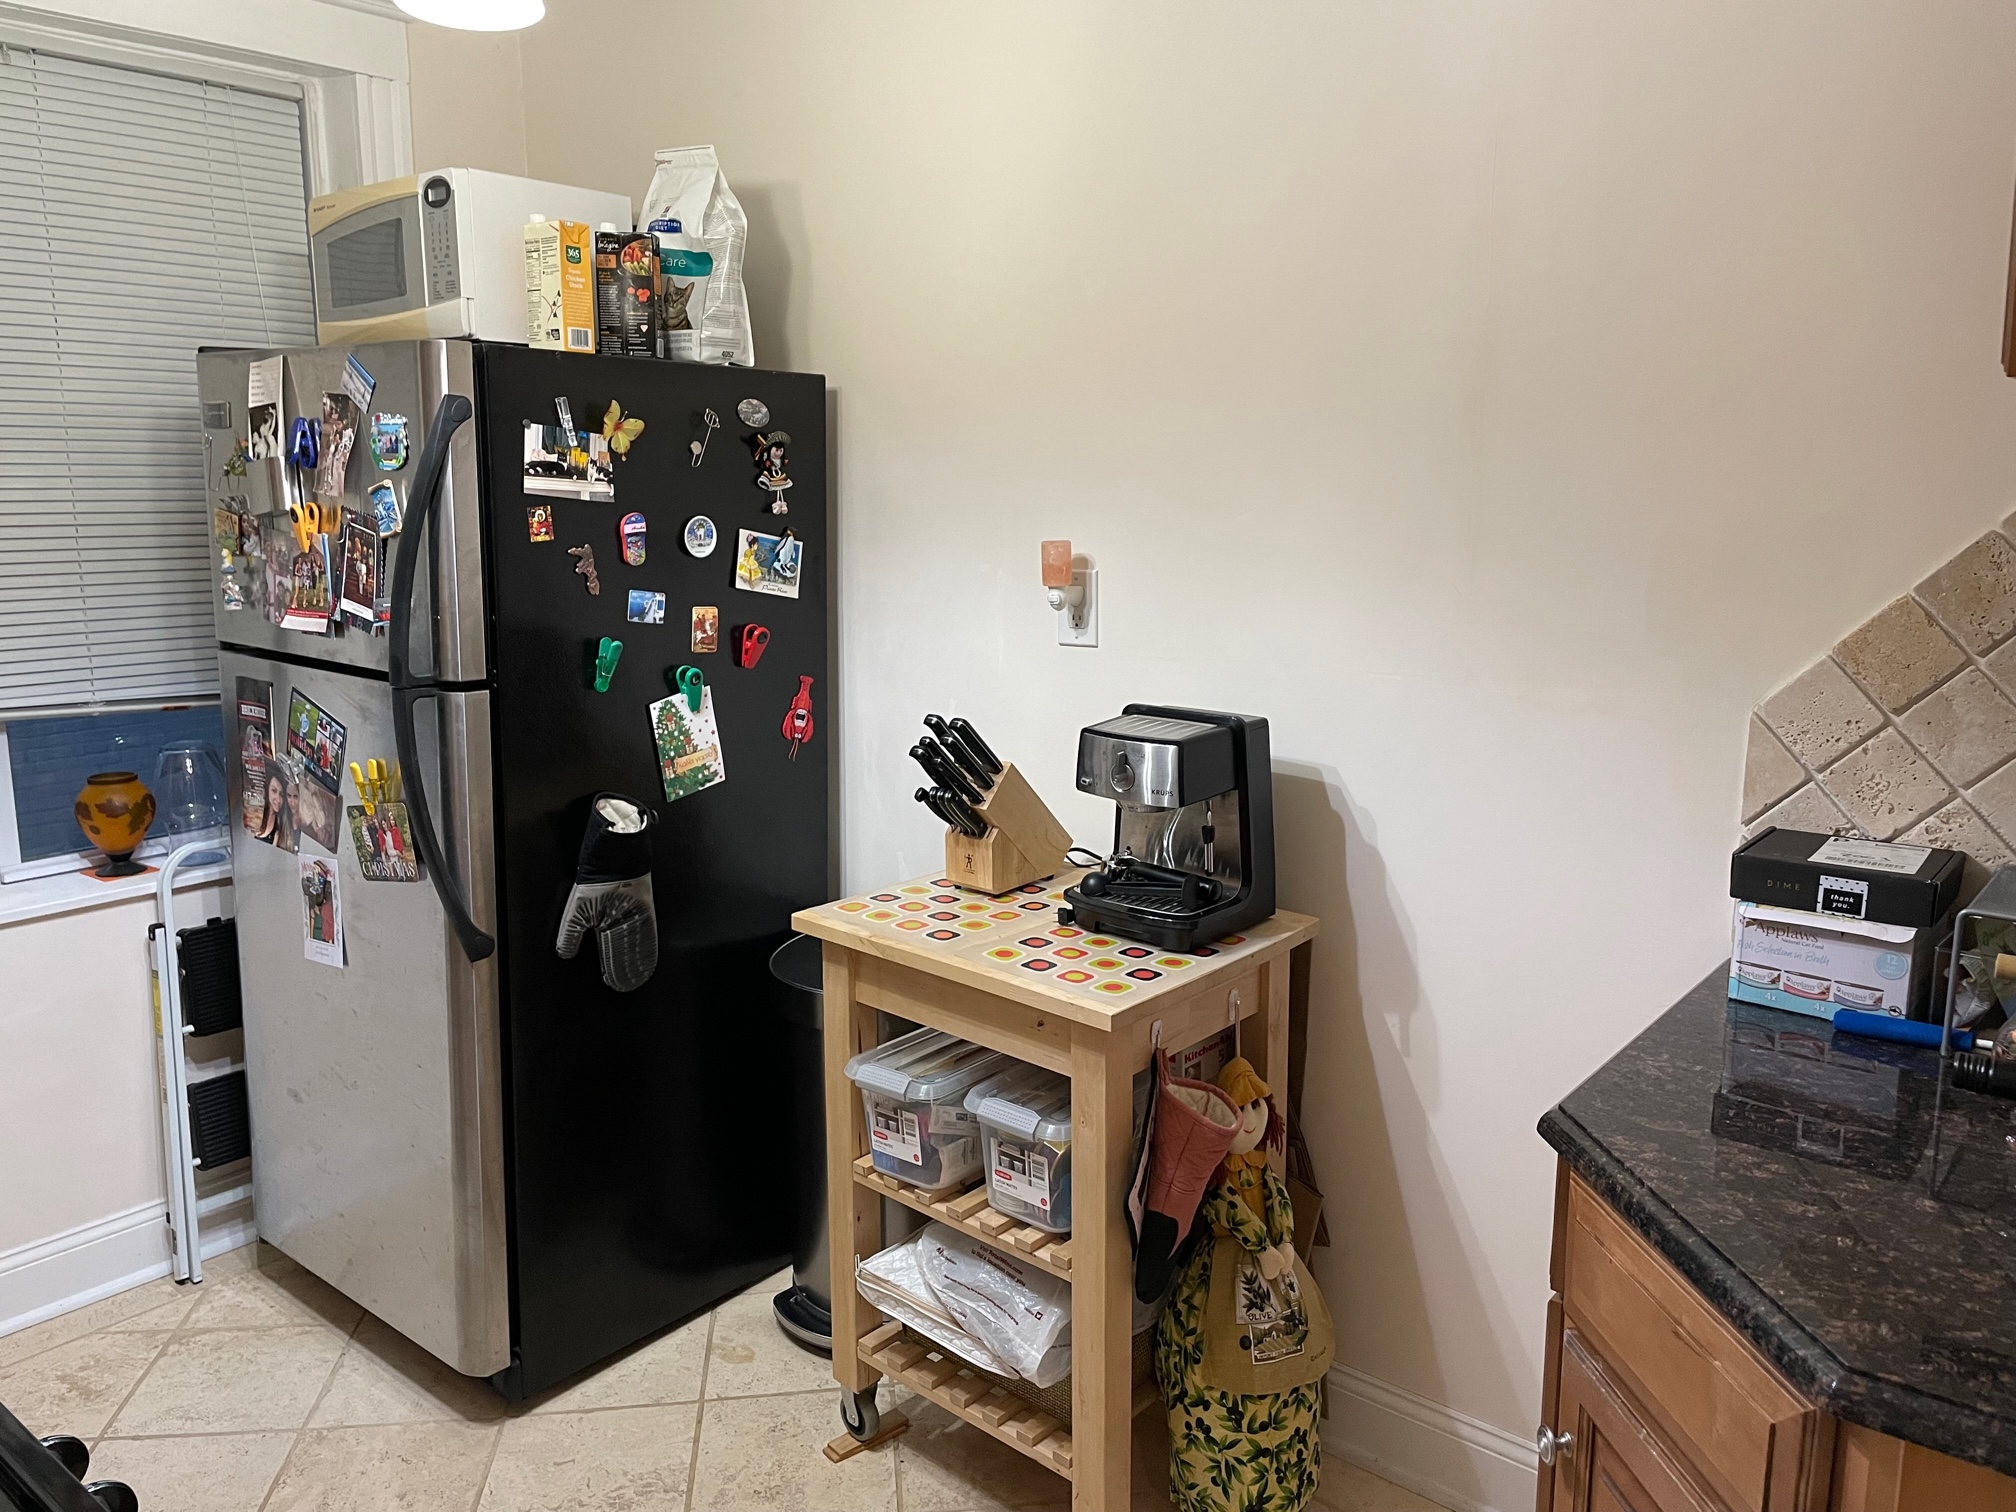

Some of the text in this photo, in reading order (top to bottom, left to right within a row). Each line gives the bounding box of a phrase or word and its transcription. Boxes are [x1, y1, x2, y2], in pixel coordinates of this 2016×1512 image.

[597, 240, 620, 252] Imagine
[567, 248, 580, 258] 365
[660, 254, 686, 268] Care
[1151, 789, 1174, 797] KRUPS
[362, 861, 415, 881] CHRISTMAS
[1767, 879, 1801, 891] DIME
[1830, 893, 1855, 903] thank
[1831, 901, 1851, 910] you.
[1754, 922, 1819, 943] Applaws
[1781, 938, 1800, 946] Natural
[1811, 942, 1825, 950] Food
[1755, 941, 1793, 958] Selection
[1793, 951, 1802, 959] in
[1804, 951, 1831, 965] Broth
[1765, 992, 1777, 1001] 4x
[1814, 1002, 1826, 1012] 4x
[1184, 1030, 1233, 1064] KitchenAid
[989, 1248, 1023, 1276] TotalWine.com
[1247, 1311, 1273, 1321] OLIVE
